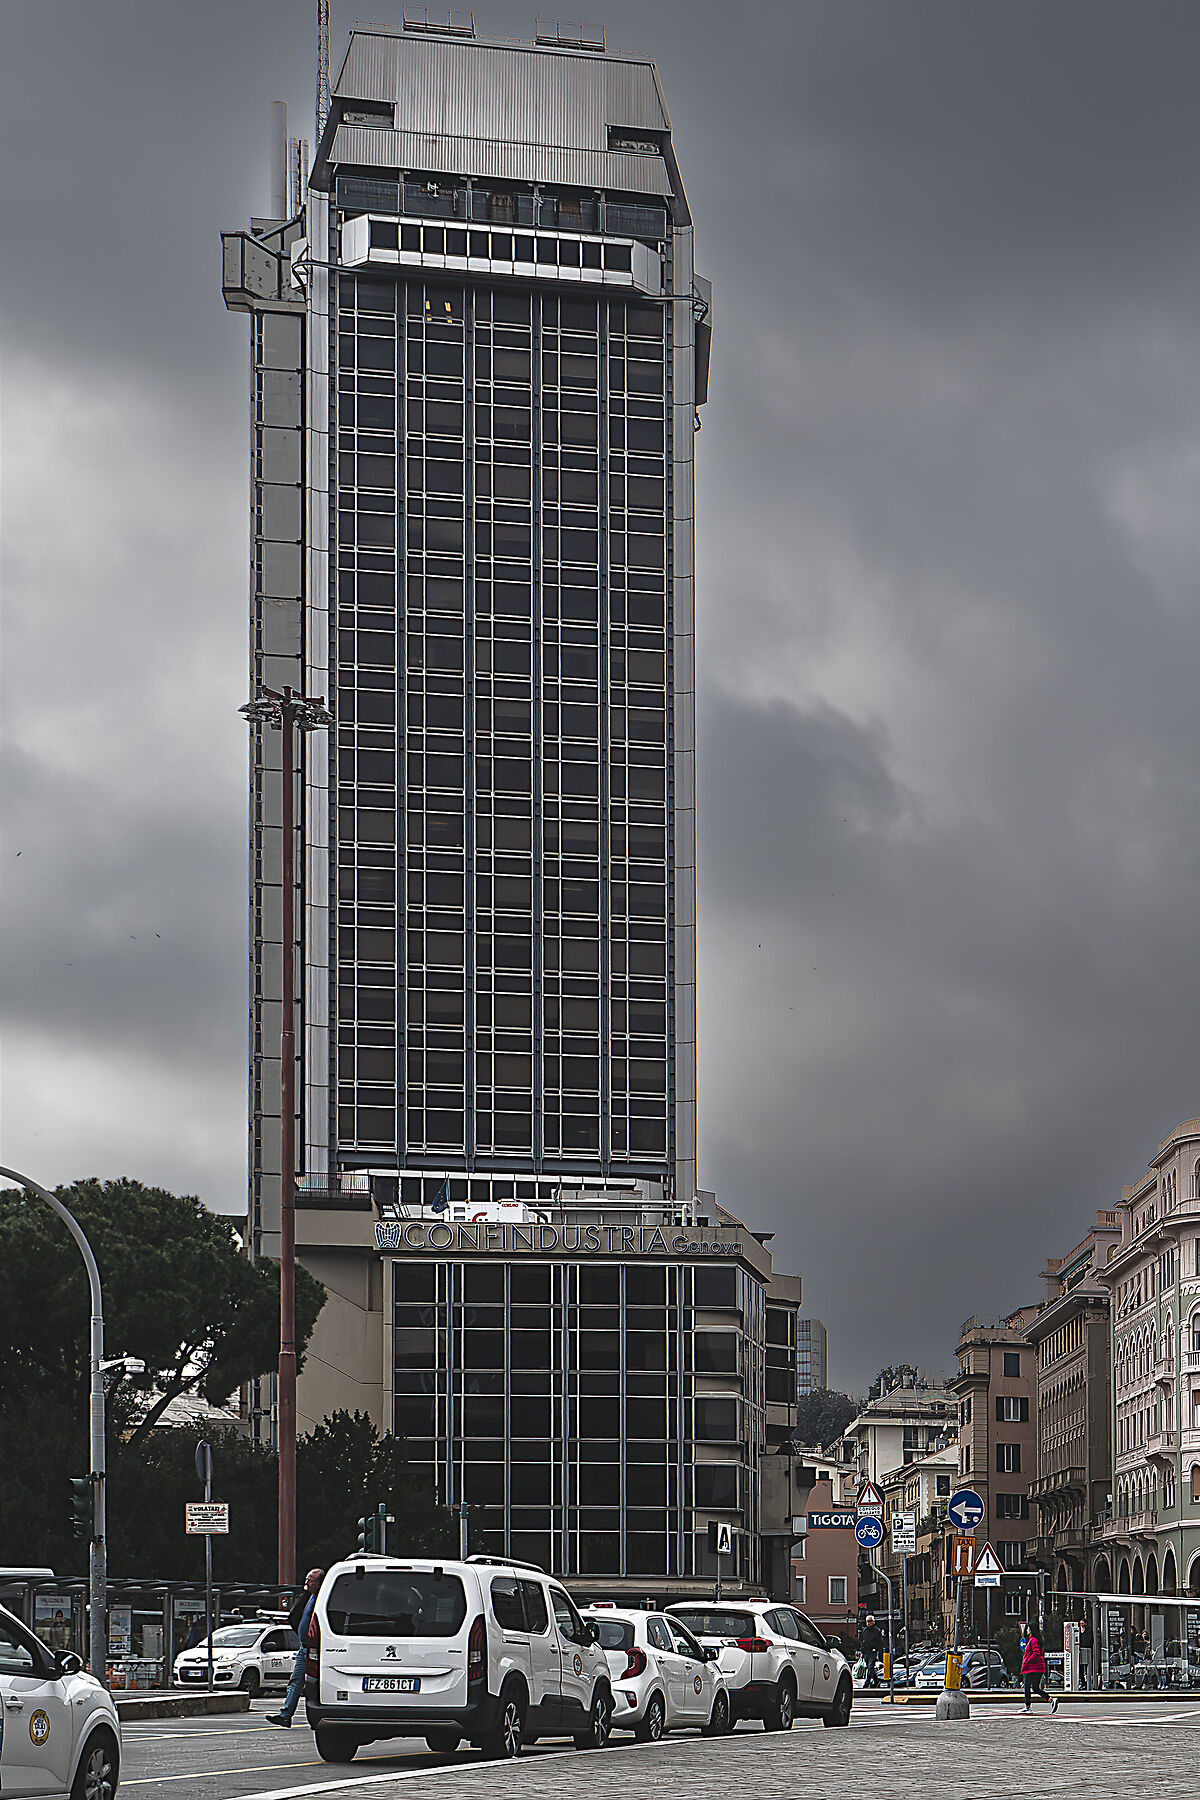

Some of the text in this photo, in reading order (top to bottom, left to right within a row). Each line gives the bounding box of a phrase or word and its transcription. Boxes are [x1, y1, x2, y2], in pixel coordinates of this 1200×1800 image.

[403, 1222, 744, 1256] CONFINDUSTRIA Genova
[719, 1526, 730, 1550] A
